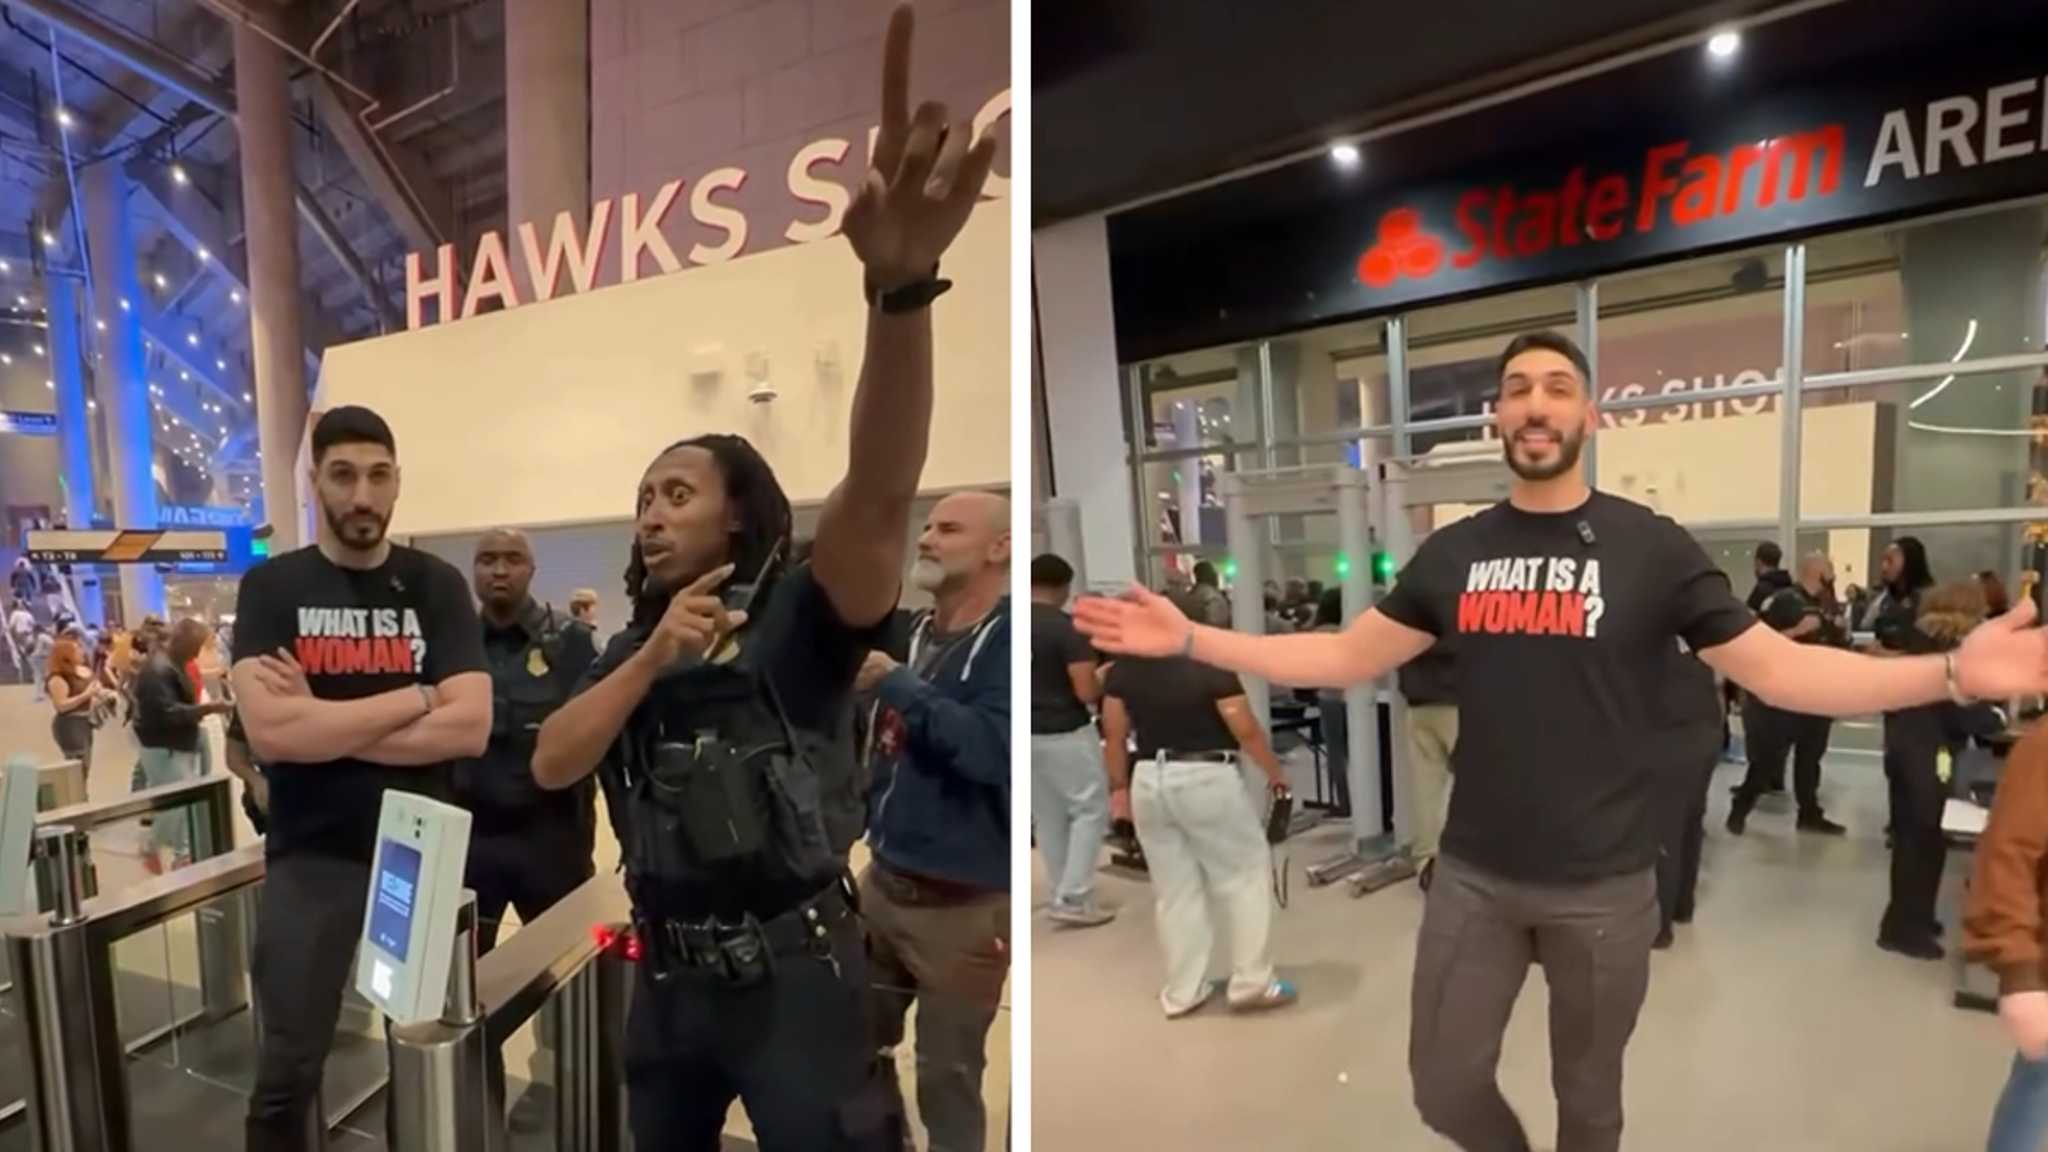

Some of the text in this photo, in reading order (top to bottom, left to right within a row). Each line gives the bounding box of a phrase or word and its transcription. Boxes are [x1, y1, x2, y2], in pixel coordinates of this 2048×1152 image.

[1451, 166, 1625, 269] State
[1635, 124, 1846, 232] Farm
[406, 166, 748, 331] HAWKS
[1466, 557, 1601, 594] WHAT IS A
[297, 607, 422, 637] WHAT IS A
[1458, 591, 1606, 638] WOMAN?
[295, 637, 427, 675] WOMAN?
